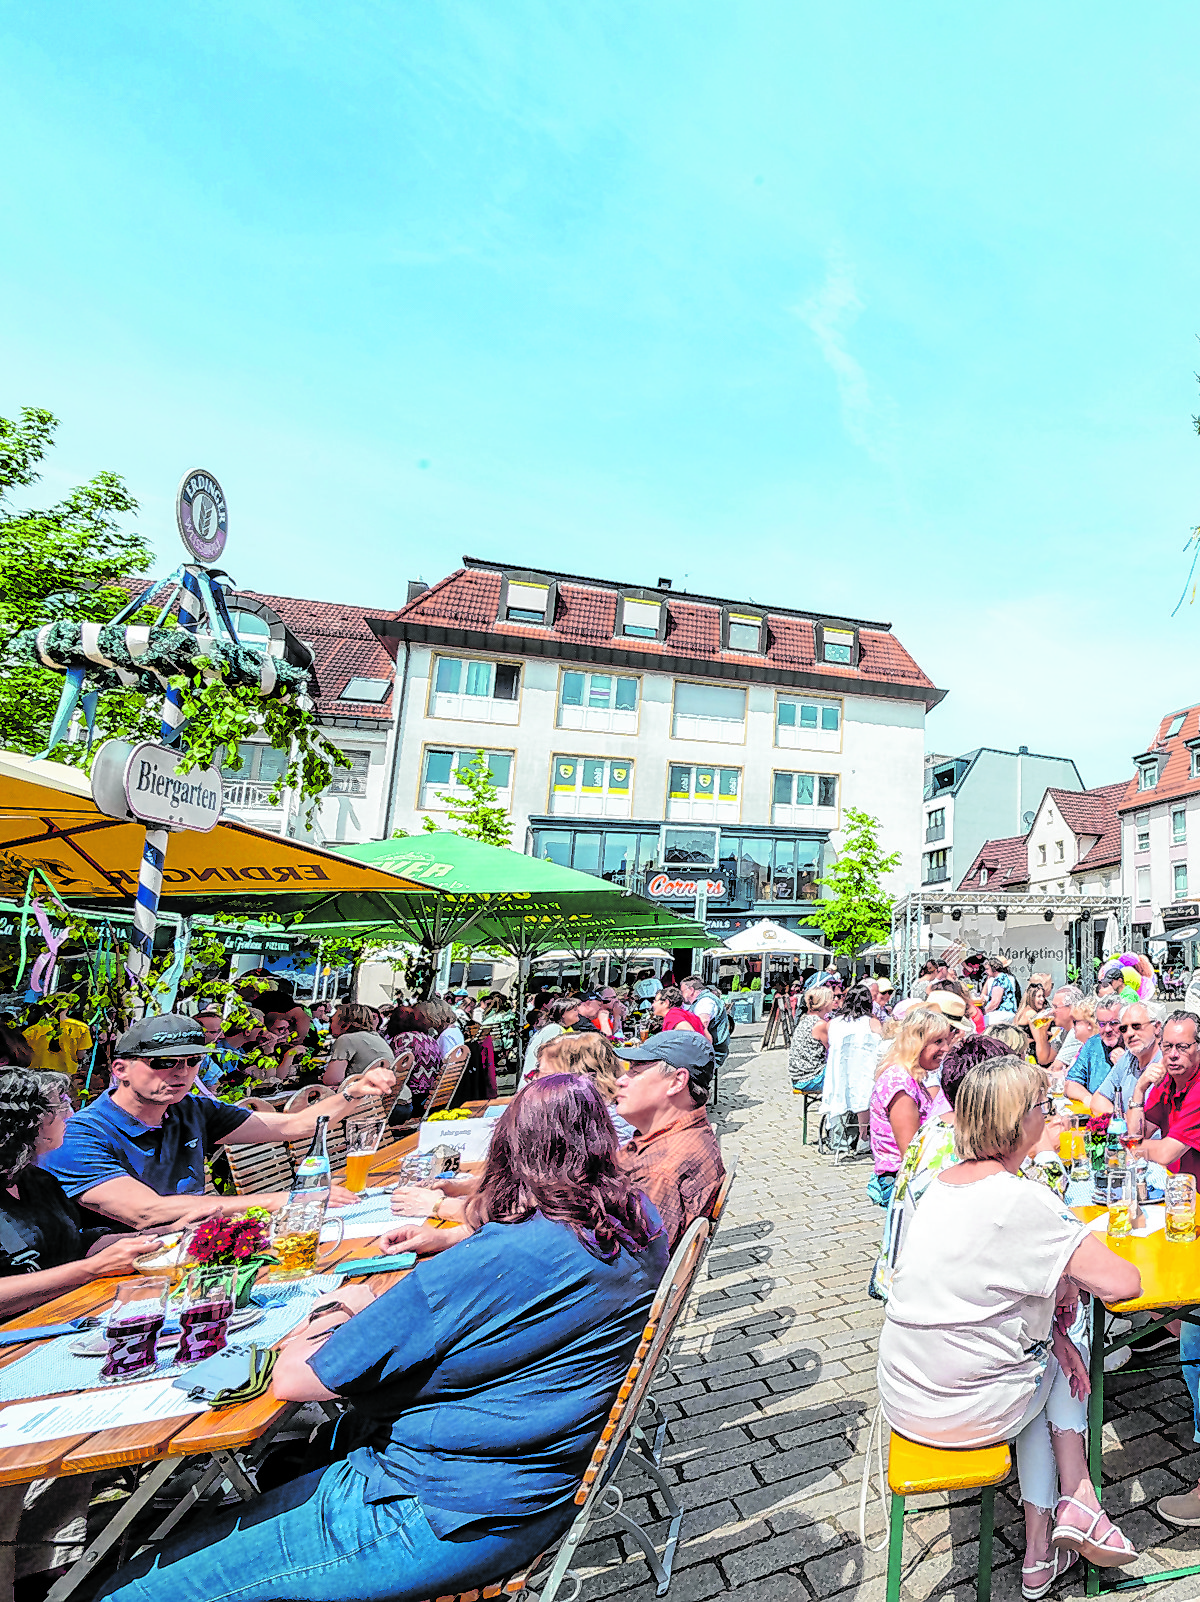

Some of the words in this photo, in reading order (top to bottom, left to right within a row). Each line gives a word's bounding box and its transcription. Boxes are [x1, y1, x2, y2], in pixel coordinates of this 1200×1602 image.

[185, 475, 227, 523] ERDINGER
[136, 760, 218, 811] Biergarten
[650, 874, 726, 898] Cornrs
[440, 1129, 471, 1137] Jahrgang
[443, 1158, 460, 1173] 25
